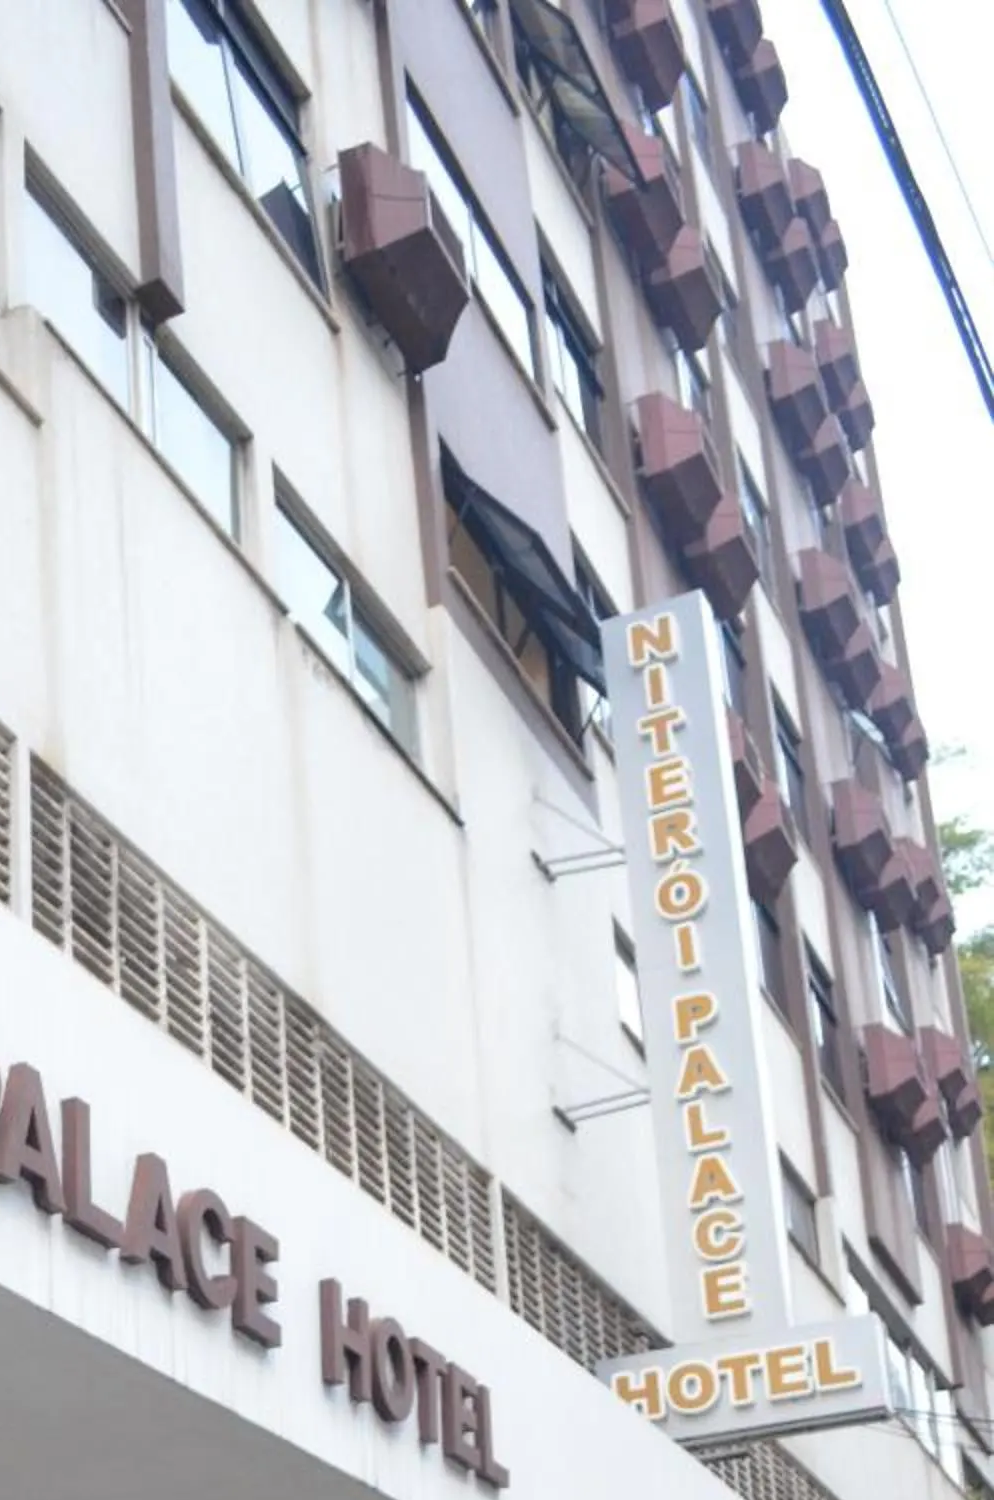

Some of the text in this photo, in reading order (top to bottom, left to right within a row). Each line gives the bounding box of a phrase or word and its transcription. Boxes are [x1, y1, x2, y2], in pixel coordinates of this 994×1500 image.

[672, 993, 751, 1321] PALACE
[320, 1277, 509, 1488] HOTEL
[611, 1336, 863, 1421] HOTEL
